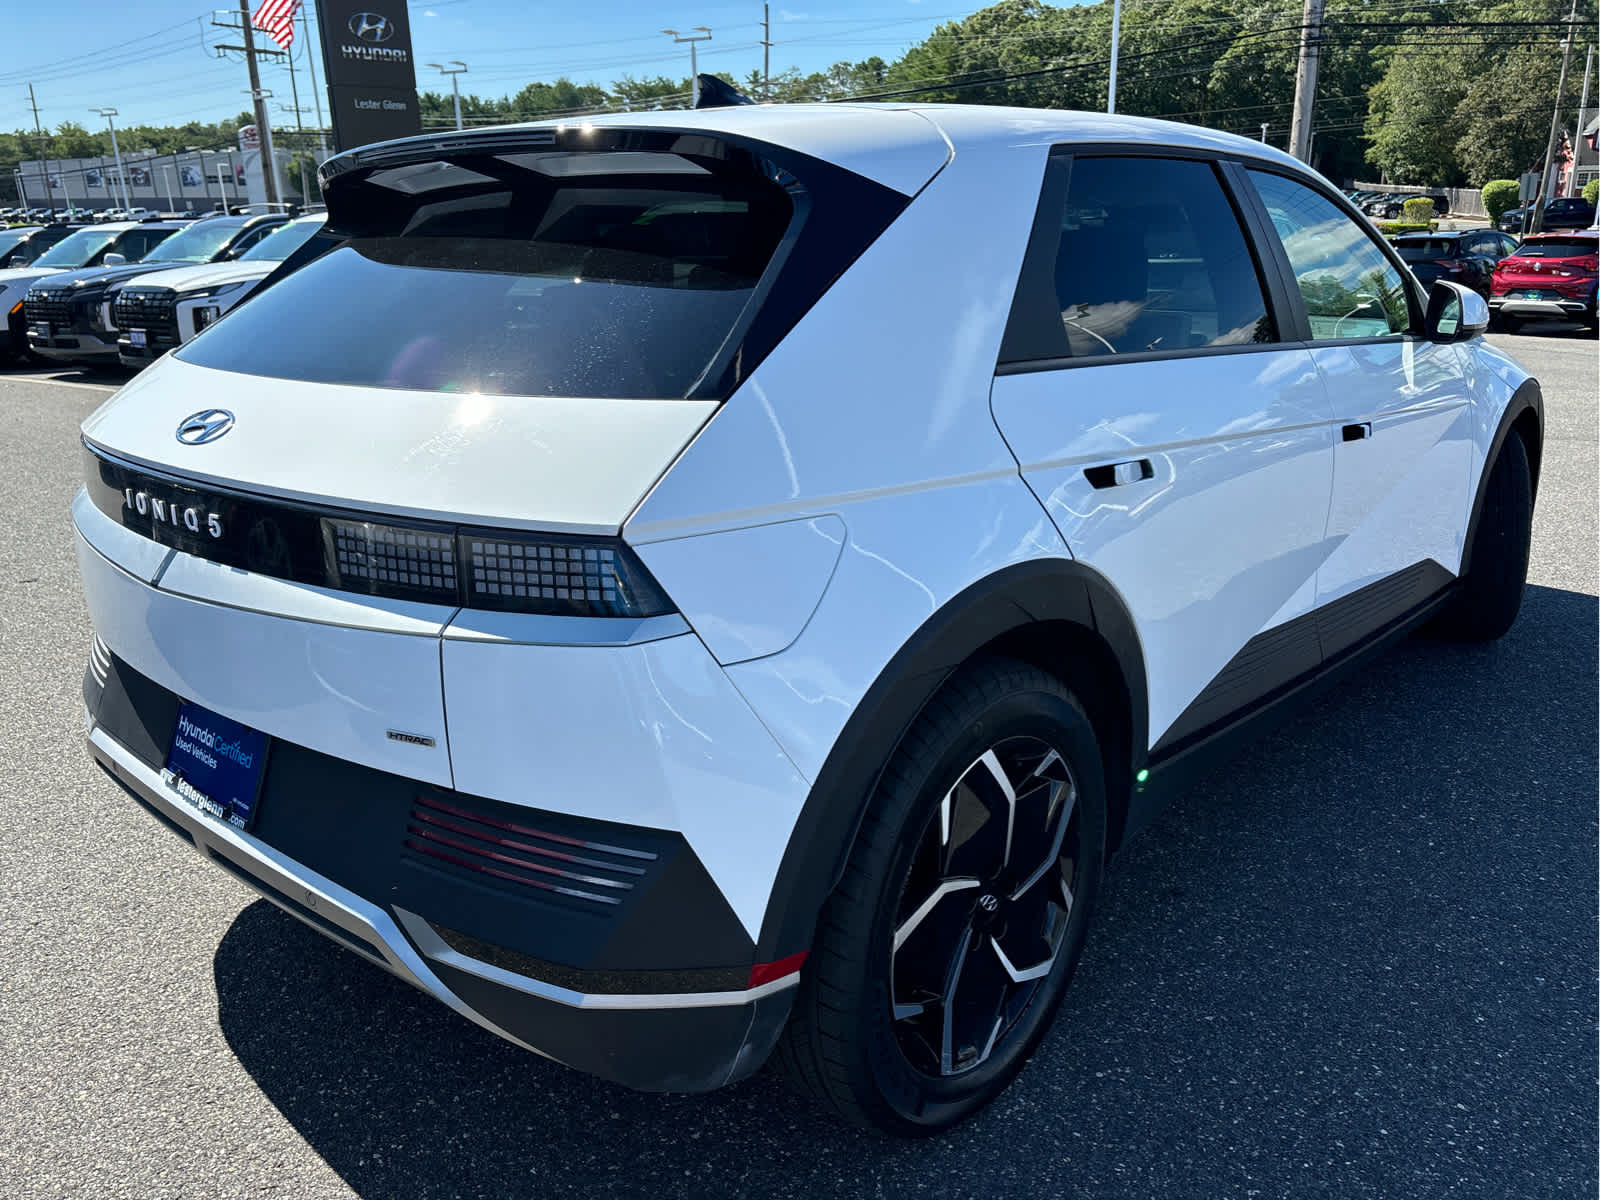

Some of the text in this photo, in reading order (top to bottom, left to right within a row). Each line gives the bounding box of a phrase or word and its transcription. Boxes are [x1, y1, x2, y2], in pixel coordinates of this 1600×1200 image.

[341, 44, 407, 62] HYUNDAI
[354, 99, 407, 111] Lester Glenn
[125, 488, 222, 538] IONIQ 5
[388, 731, 432, 747] HTRAC
[175, 735, 193, 753] Used
[192, 743, 218, 769] Vehicles
